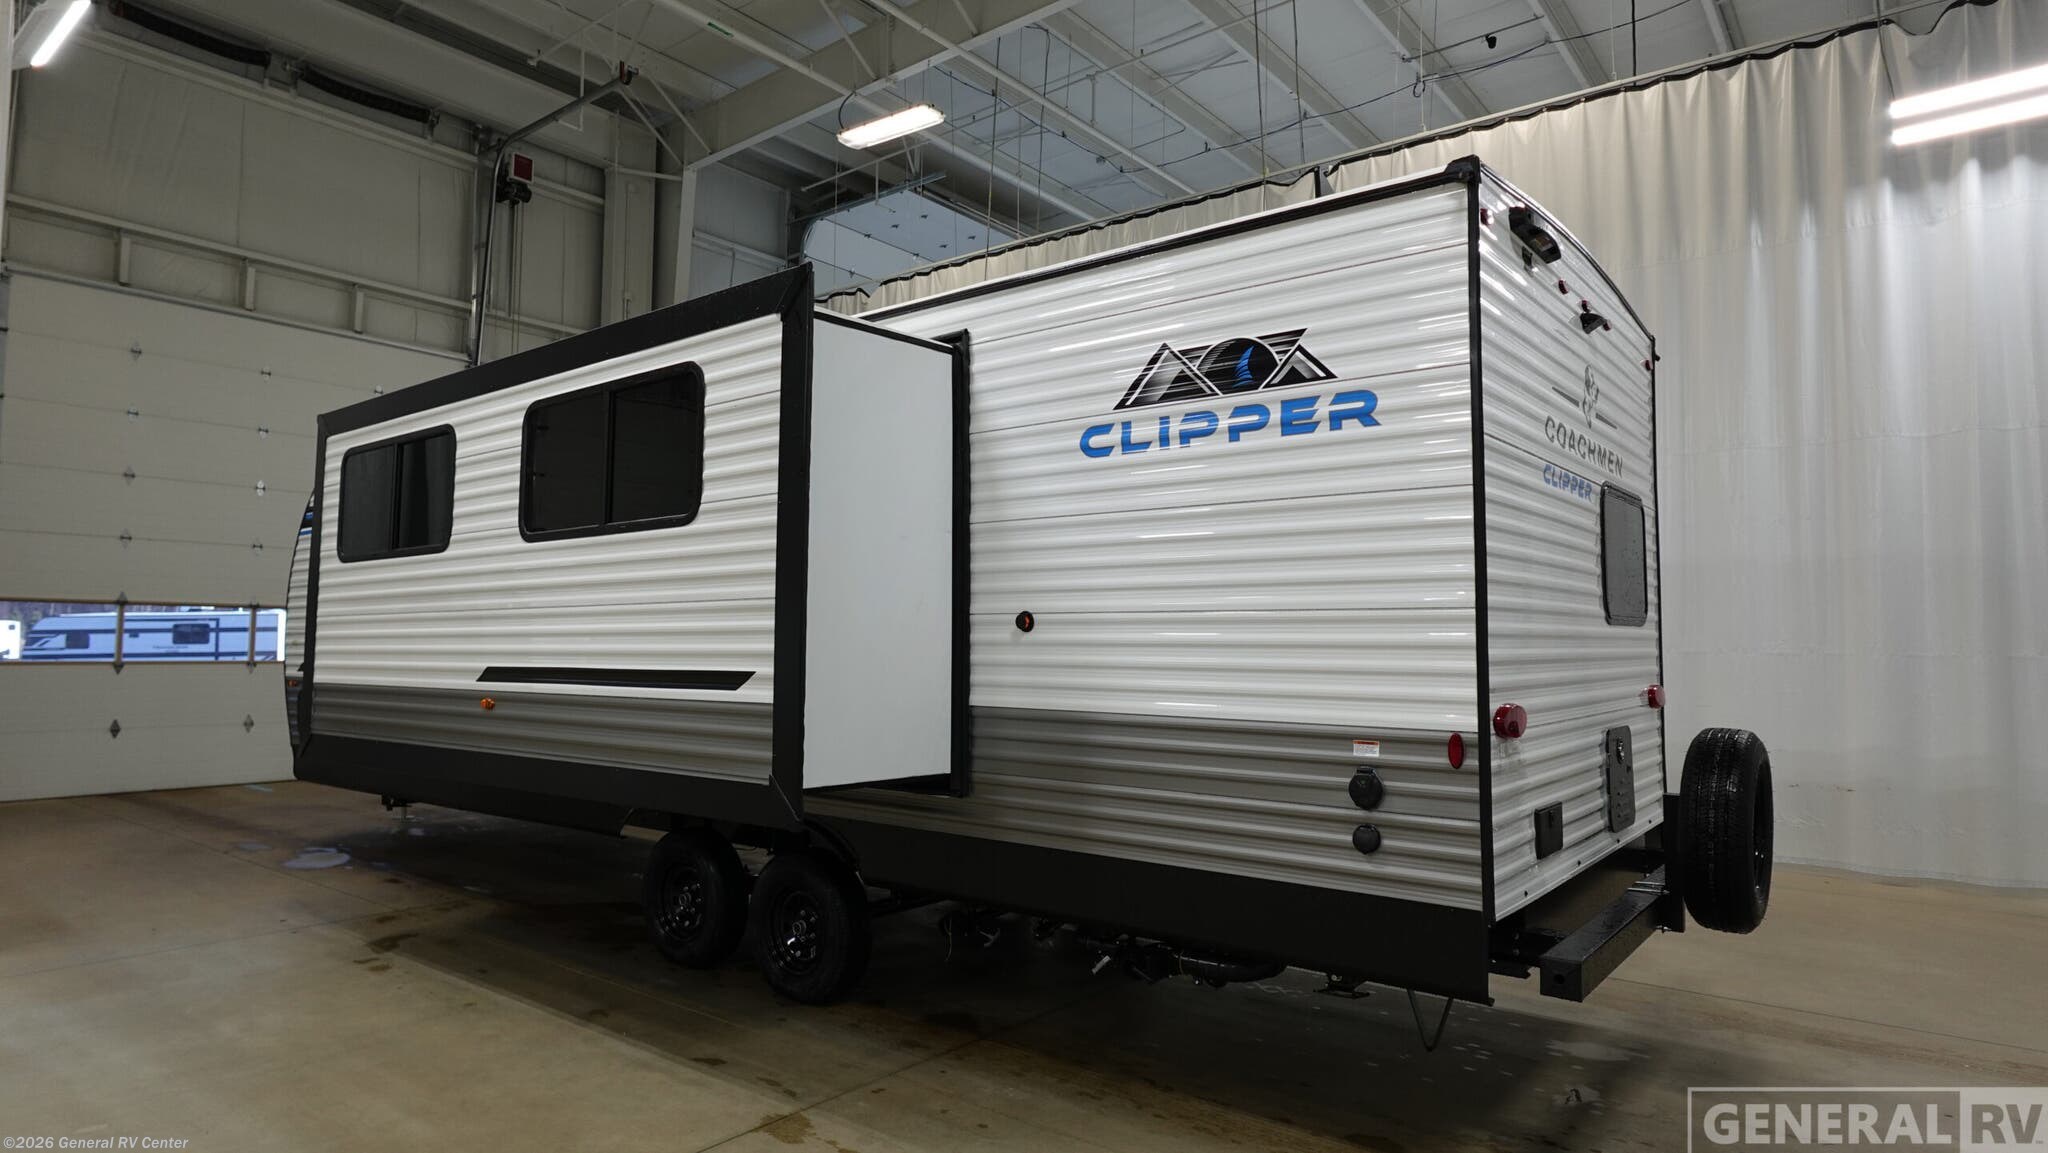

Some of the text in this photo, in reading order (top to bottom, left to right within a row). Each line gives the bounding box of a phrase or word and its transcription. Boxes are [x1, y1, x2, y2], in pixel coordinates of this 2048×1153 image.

[1079, 389, 1382, 458] CLIPPER
[1544, 415, 1623, 479] COACHMEN
[1543, 463, 1593, 503] CLIPPER
